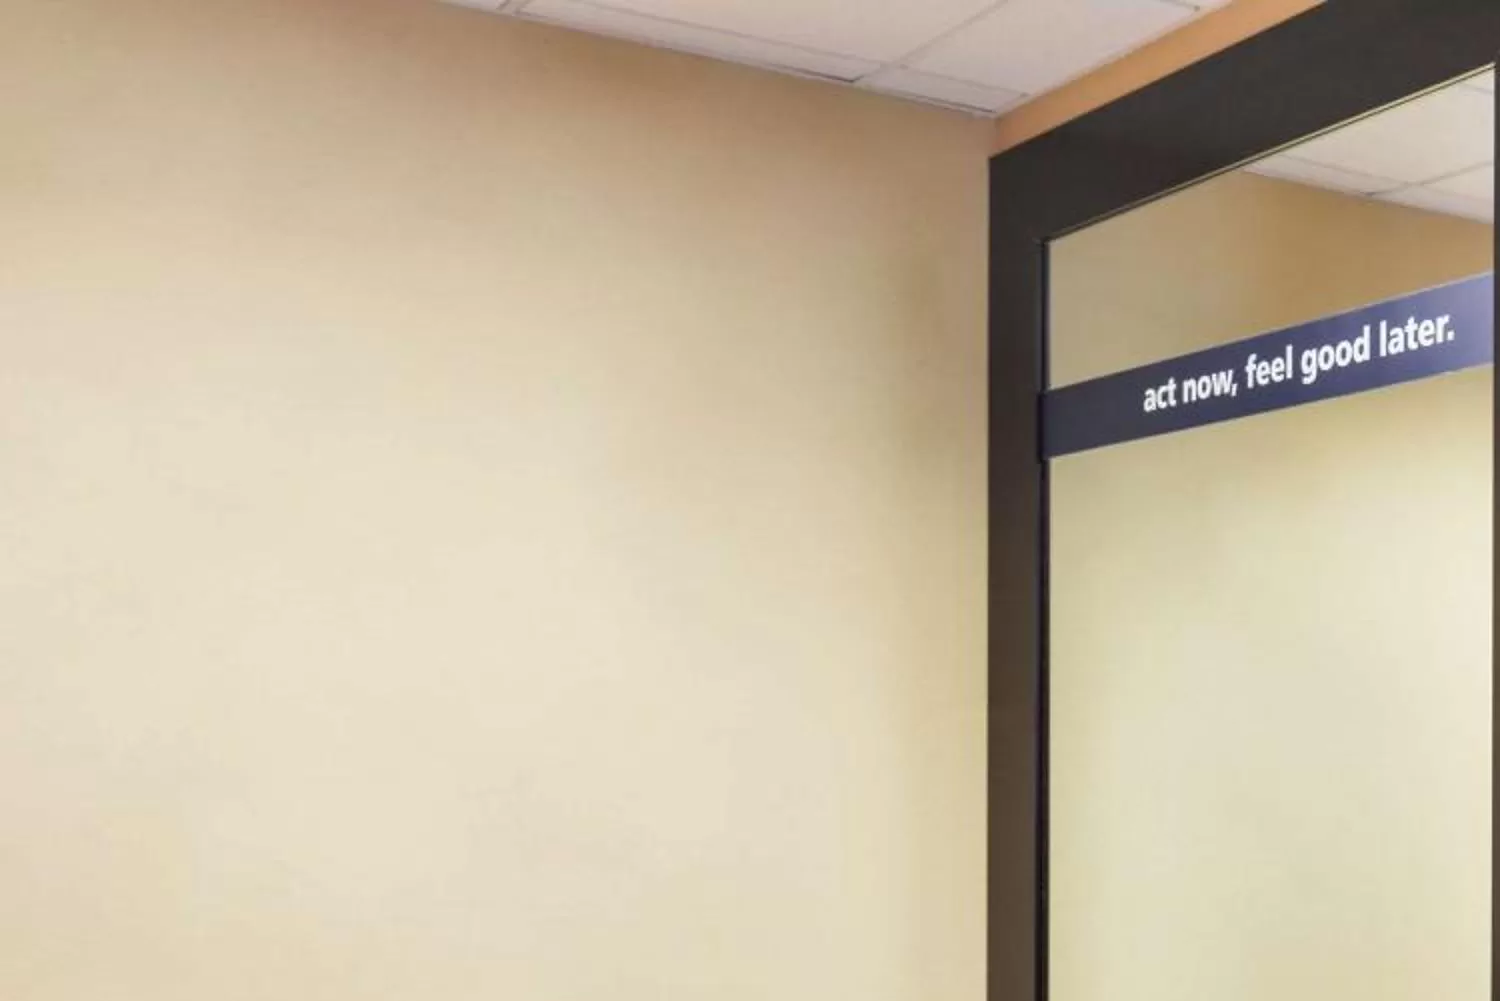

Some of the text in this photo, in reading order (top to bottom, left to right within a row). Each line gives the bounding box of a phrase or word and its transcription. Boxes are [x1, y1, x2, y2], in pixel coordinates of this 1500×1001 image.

[1142, 313, 1455, 412] act now, feel good later.
